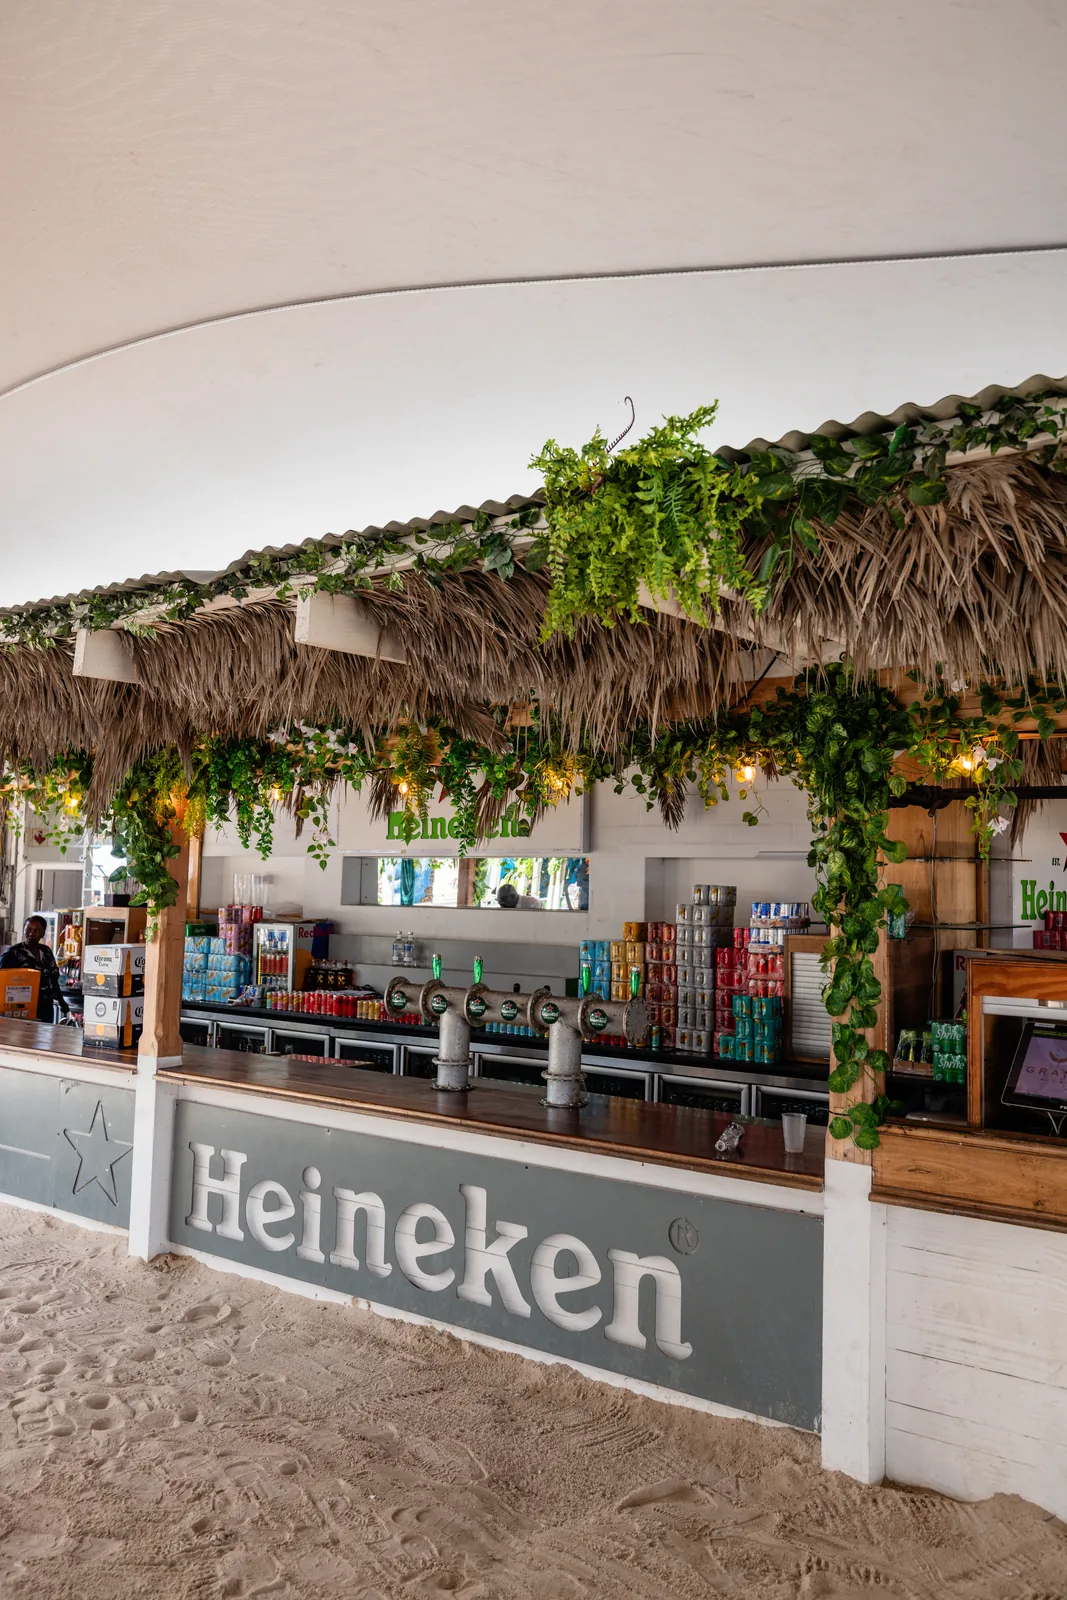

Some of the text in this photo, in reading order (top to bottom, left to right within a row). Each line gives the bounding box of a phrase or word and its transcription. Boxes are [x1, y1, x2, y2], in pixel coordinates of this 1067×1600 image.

[386, 811, 519, 839] Heineen
[298, 927, 315, 938] Red
[94, 955, 113, 963] Corona
[936, 1027, 962, 1040] Sprite
[938, 1055, 965, 1069] Sprite
[185, 1141, 693, 1361] Heineken
